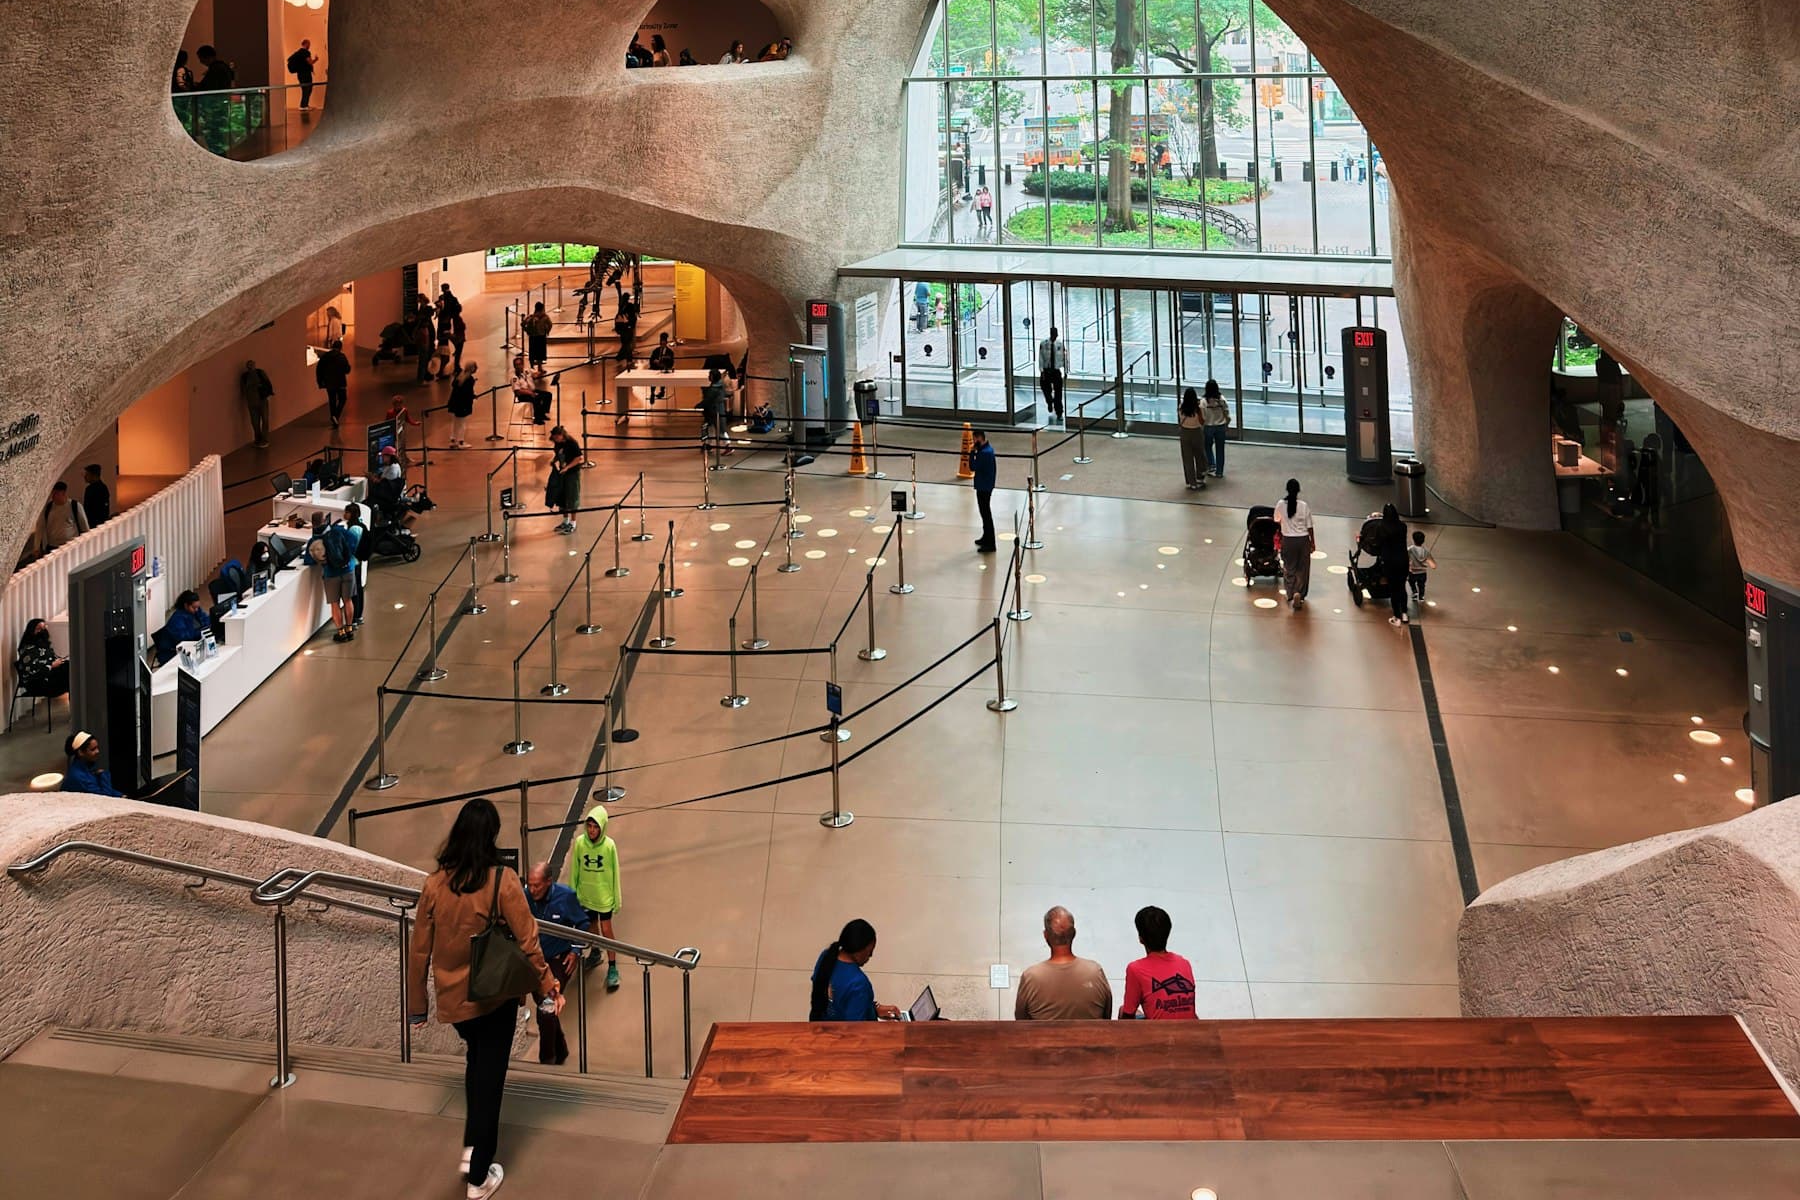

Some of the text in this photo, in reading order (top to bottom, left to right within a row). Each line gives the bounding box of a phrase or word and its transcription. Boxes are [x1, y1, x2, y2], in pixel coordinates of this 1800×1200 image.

[812, 304, 827, 316] EXIT
[1355, 332, 1374, 346] EXIT
[9, 413, 40, 439] Griffin
[6, 434, 40, 457] Atrium
[132, 546, 144, 573] EXIT
[1747, 583, 1765, 614] EXIT
